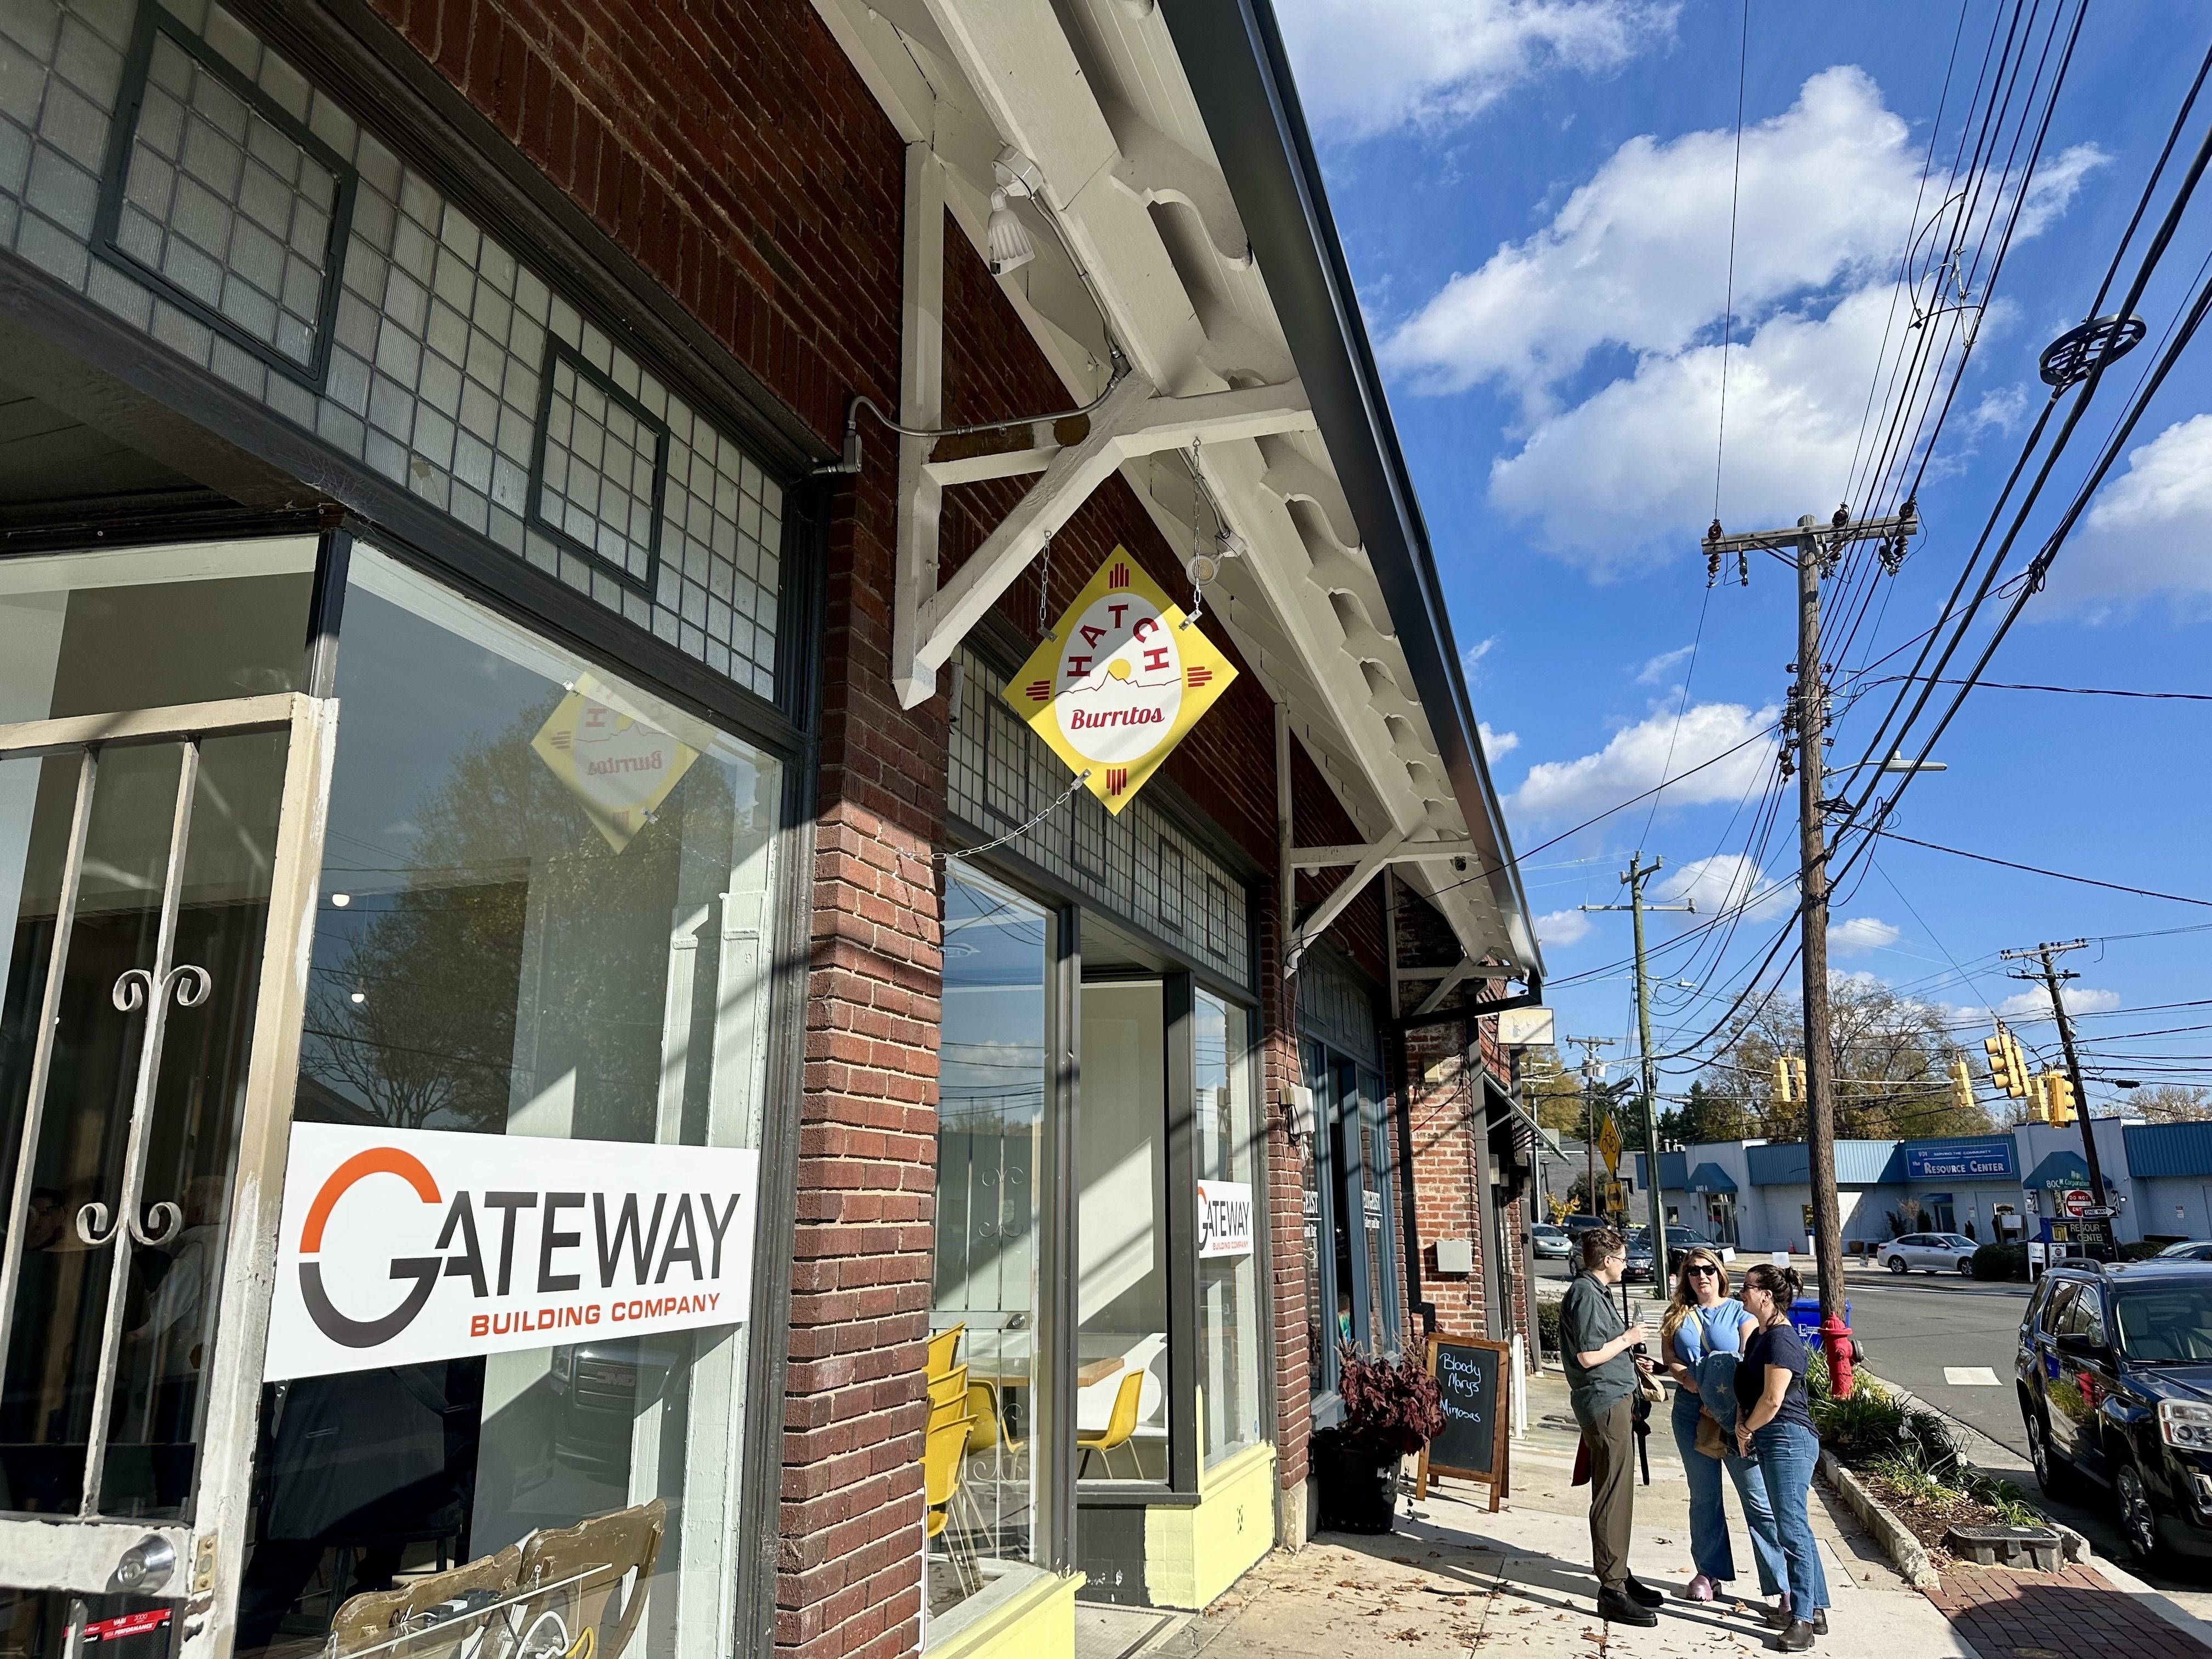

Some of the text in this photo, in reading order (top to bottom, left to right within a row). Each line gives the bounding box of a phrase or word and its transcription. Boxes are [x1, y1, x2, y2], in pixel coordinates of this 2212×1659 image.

[1066, 603, 1170, 679] HATCH
[1071, 707, 1165, 730] Burritos
[1923, 1160, 2004, 1174] RESOURCE CENTER
[298, 1146, 741, 1348] GATEWAY
[1212, 1240, 1249, 1250] BUILDING COMPANY
[470, 1292, 721, 1338] BUILDING COMPANY
[1440, 1352, 1481, 1383] Bloody
[1448, 1372, 1480, 1398] Marys
[1440, 1398, 1481, 1423] Mimosas
[114, 1622, 154, 1636] PERFORMANCE
